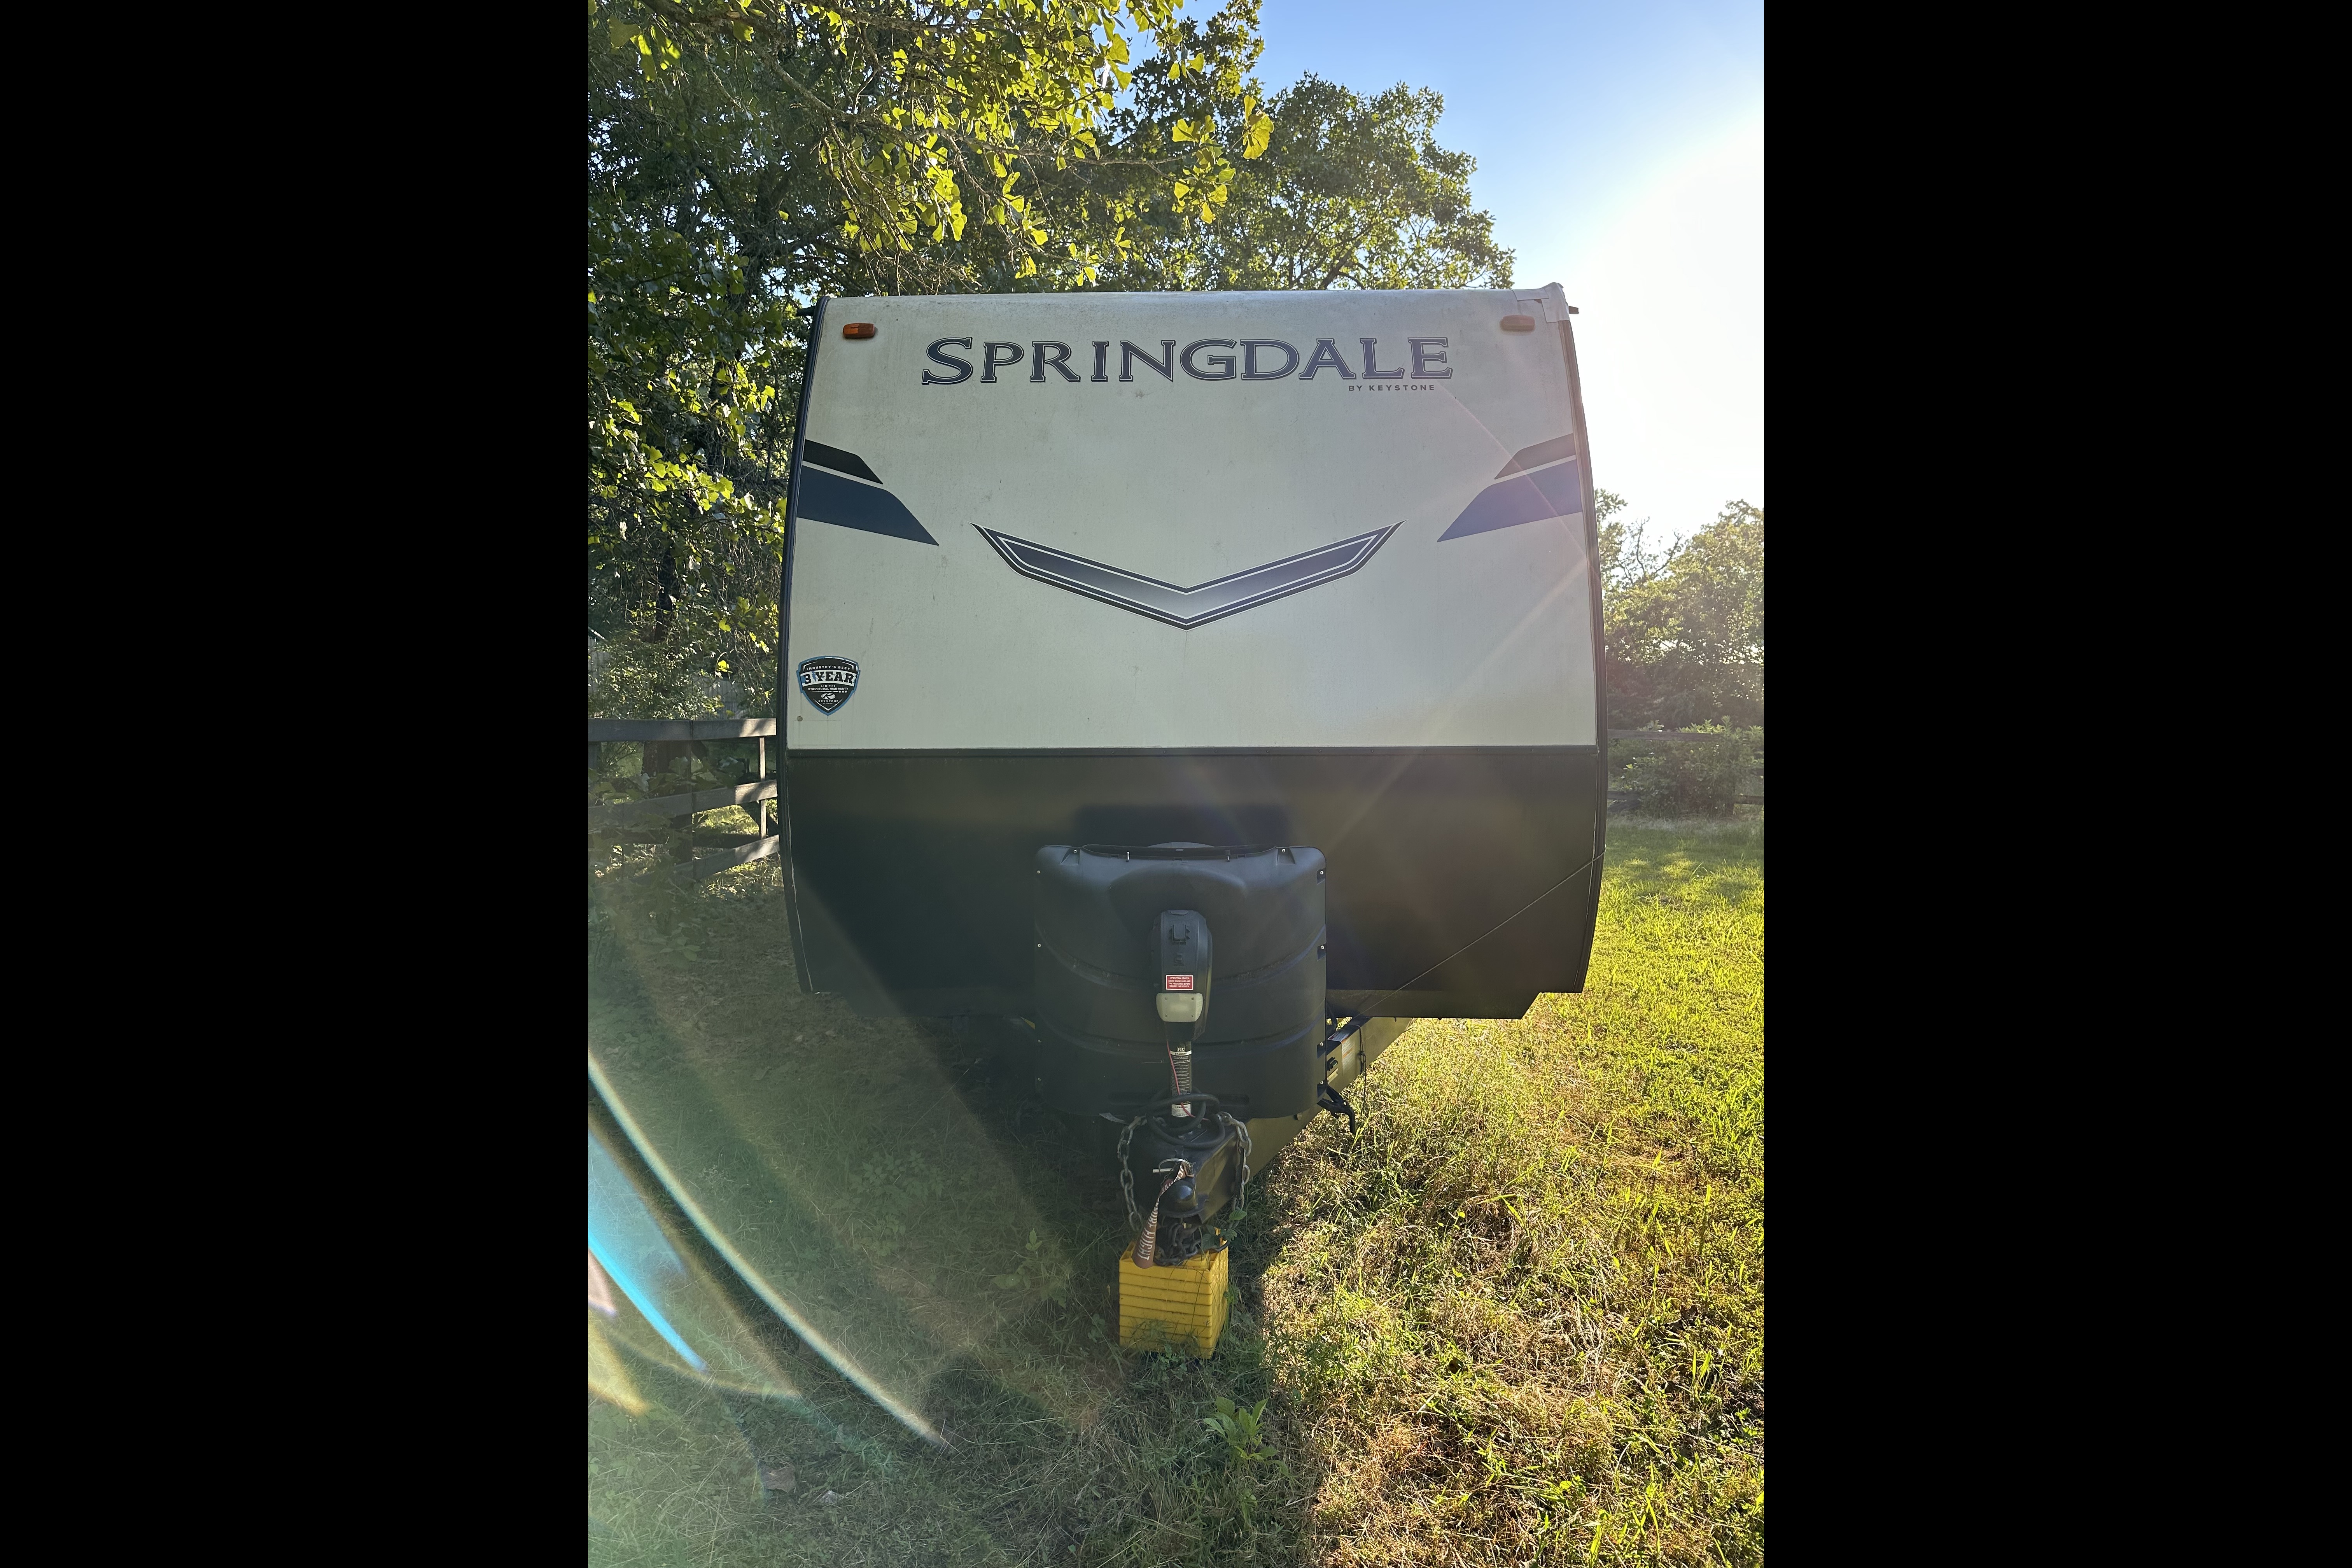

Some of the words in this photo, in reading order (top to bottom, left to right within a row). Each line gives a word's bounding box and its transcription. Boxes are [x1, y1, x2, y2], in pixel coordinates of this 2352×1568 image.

[922, 337, 1453, 385] SPRINGDALE
[804, 674, 812, 684] 3
[815, 671, 854, 684] YEAR
[1137, 1227, 1155, 1260] FLIGHT
